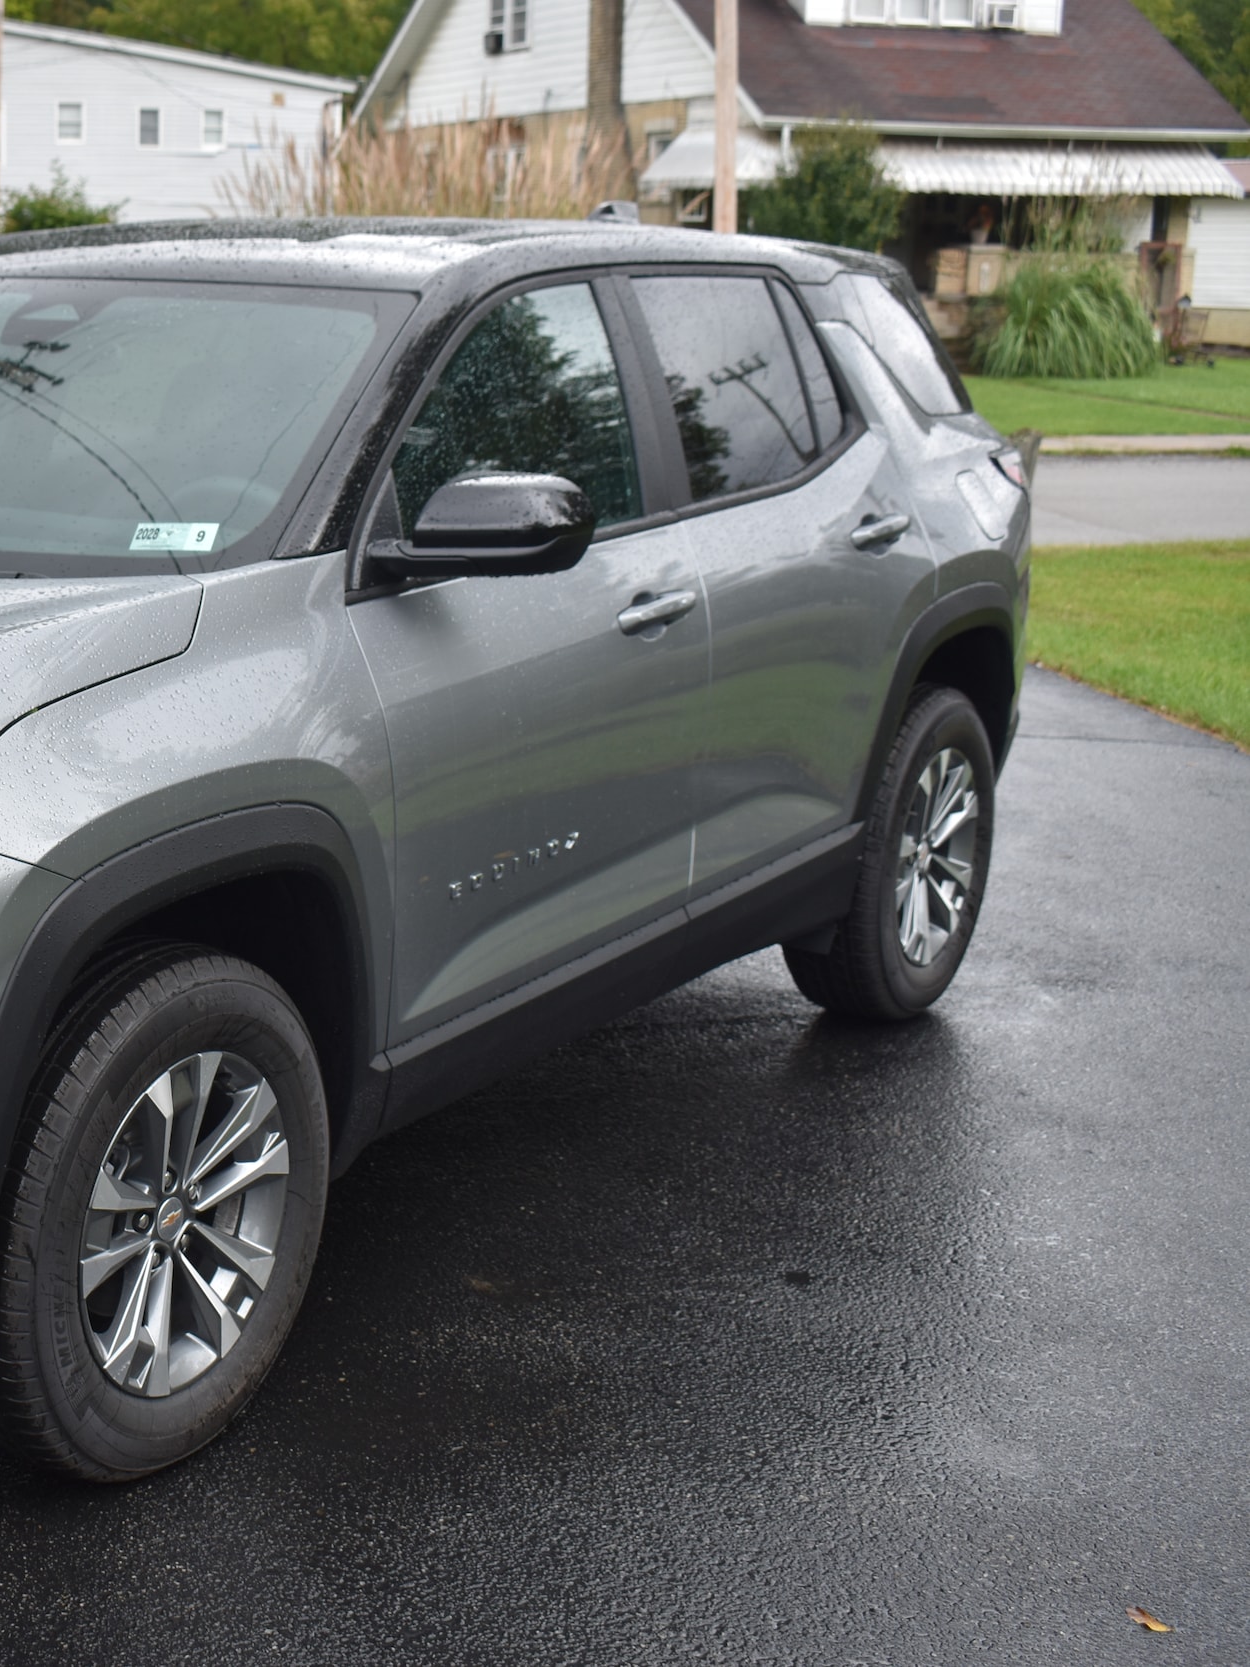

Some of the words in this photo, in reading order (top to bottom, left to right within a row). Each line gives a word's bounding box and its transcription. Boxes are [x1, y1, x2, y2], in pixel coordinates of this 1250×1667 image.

[135, 528, 160, 540] 2028
[195, 530, 206, 543] 9
[449, 831, 579, 899] EQUINOX
